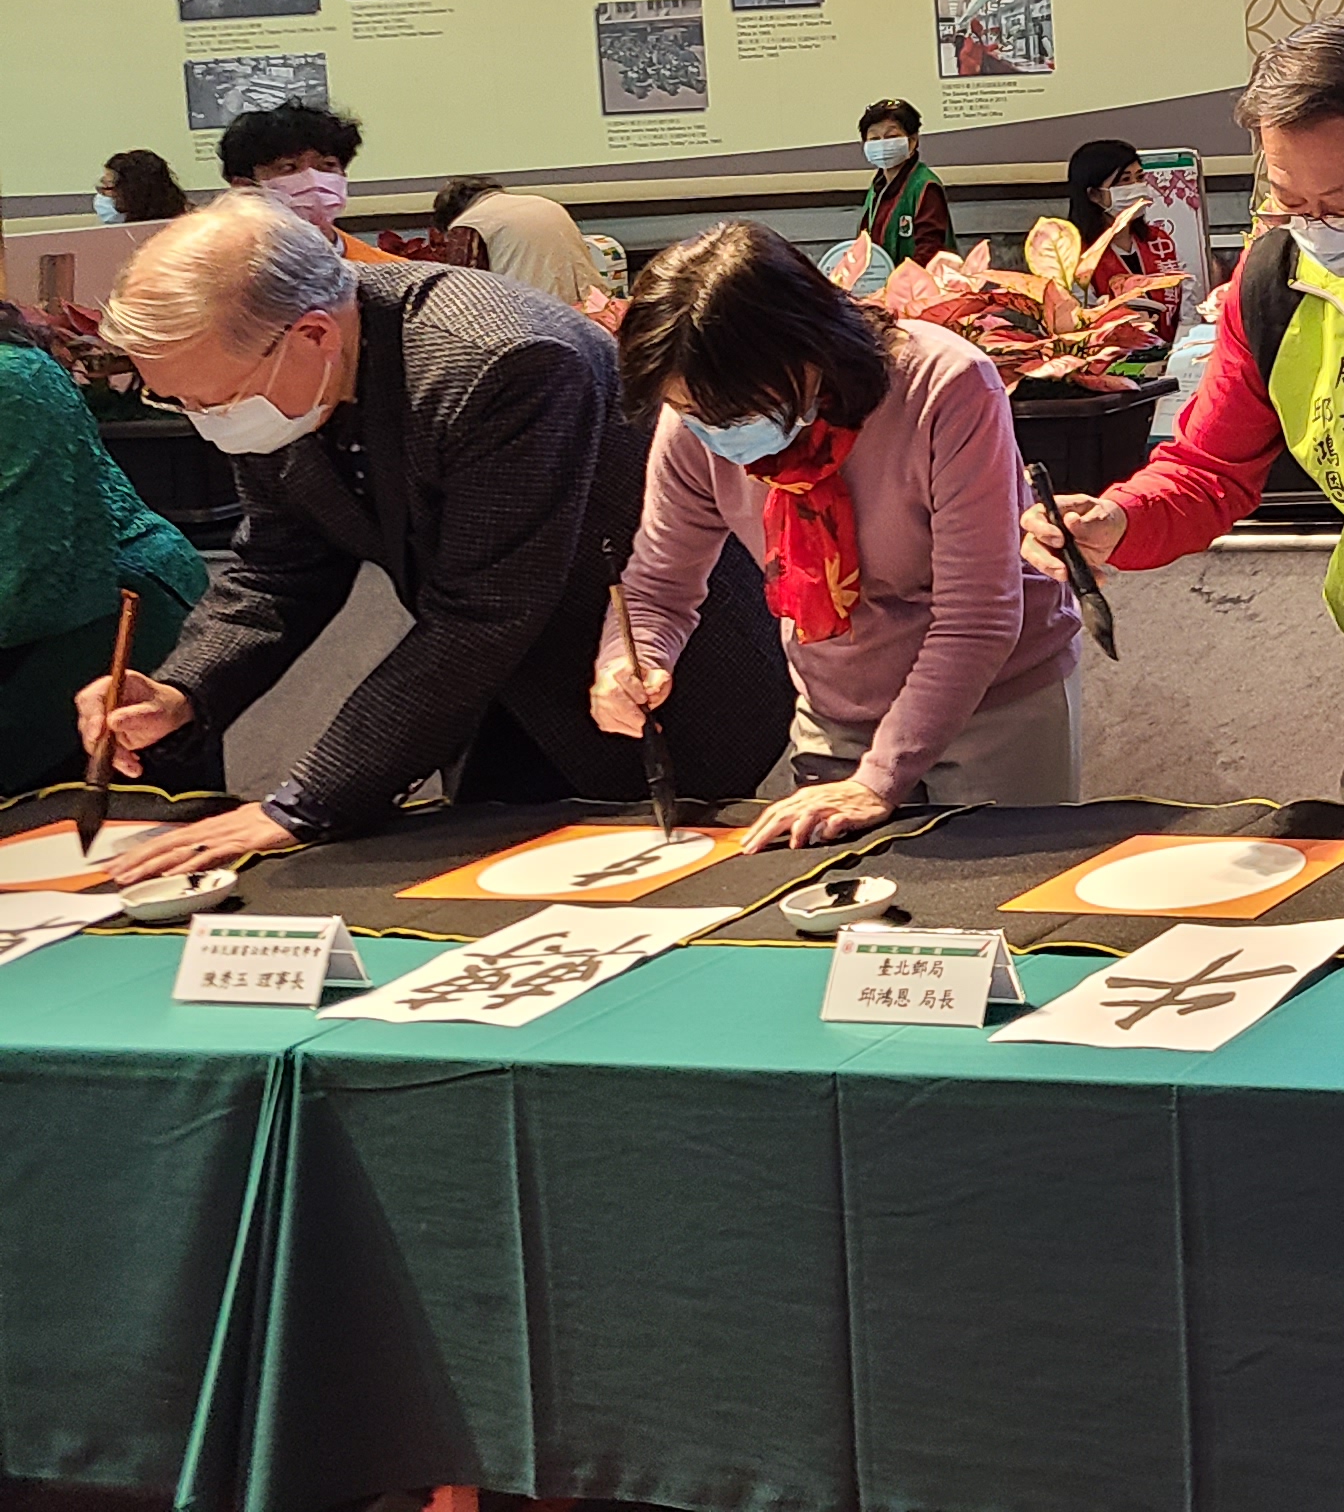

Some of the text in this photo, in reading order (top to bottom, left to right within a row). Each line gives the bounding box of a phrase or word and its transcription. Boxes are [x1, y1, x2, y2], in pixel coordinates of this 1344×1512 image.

[877, 957, 944, 978] 臺北郵局
[857, 986, 956, 1010] 邱鴻恩 局長
[1099, 949, 1298, 1031] 牛
